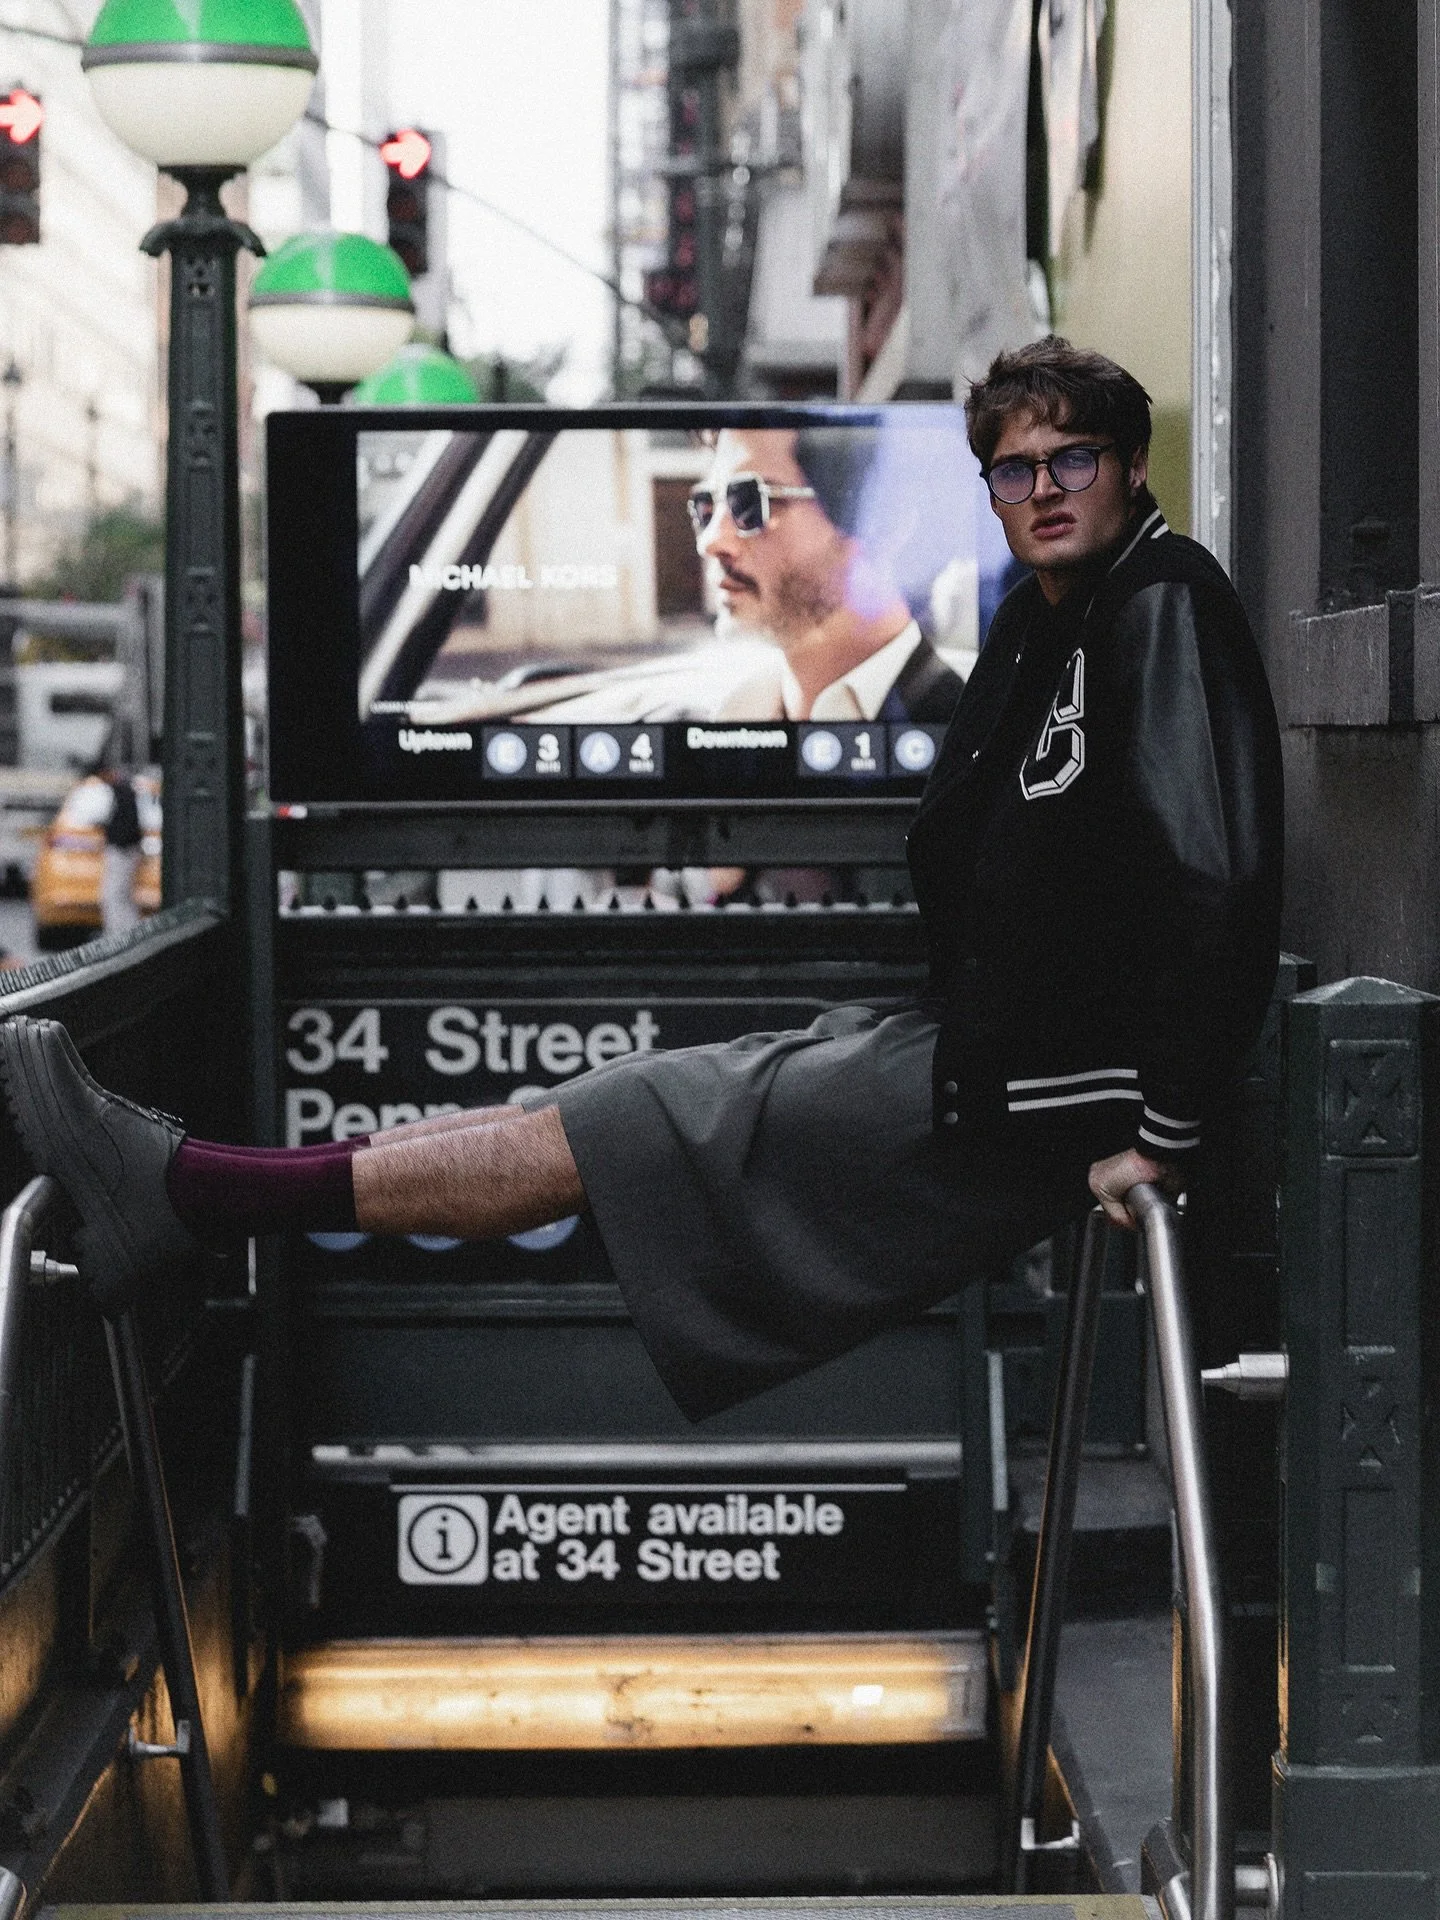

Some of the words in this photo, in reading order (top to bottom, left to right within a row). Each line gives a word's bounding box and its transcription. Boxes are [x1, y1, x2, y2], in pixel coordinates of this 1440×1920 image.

[399, 728, 472, 755] Uptown
[538, 733, 560, 762] 3
[630, 732, 653, 760] 4
[687, 726, 788, 750] Downtown
[855, 731, 871, 759] 1
[285, 1006, 389, 1075] 34
[424, 1006, 660, 1076] Street
[284, 1088, 463, 1149] Pen
[493, 1494, 631, 1544] Agent
[646, 1493, 845, 1536] available
[492, 1541, 540, 1581] at
[556, 1538, 621, 1582] 34
[636, 1538, 781, 1582] Street
